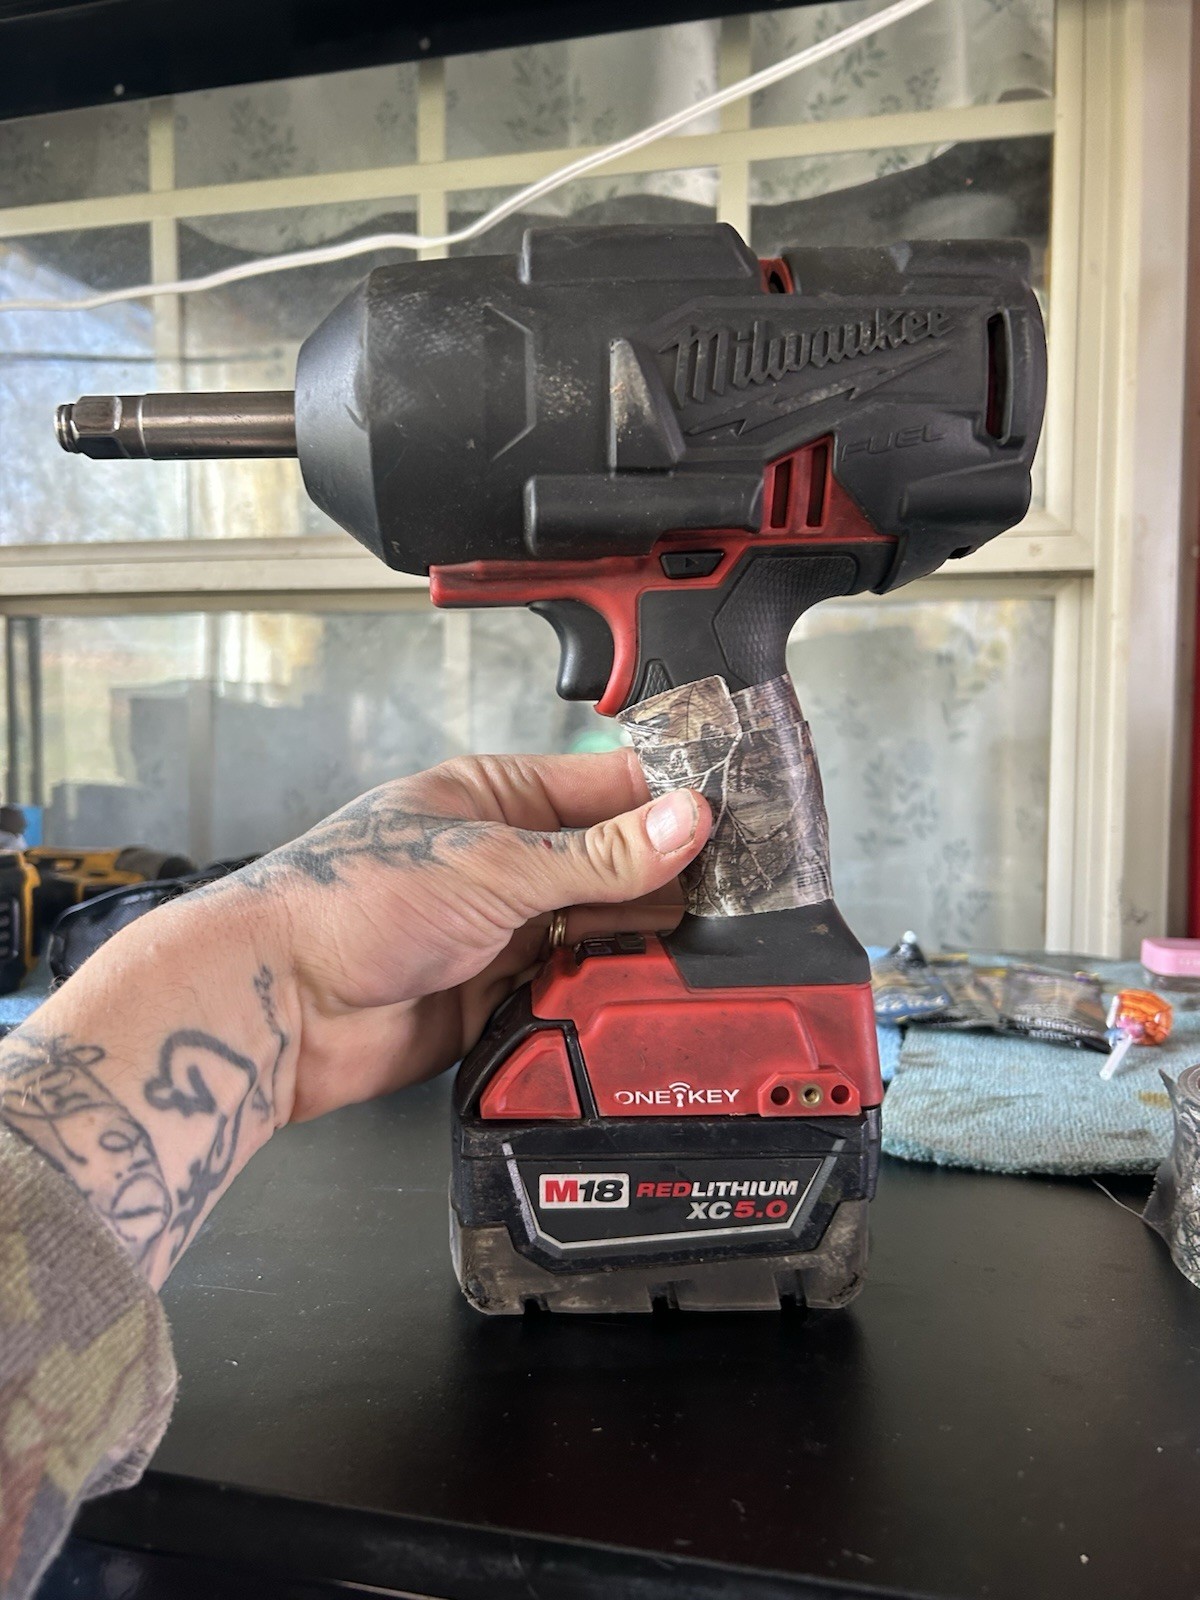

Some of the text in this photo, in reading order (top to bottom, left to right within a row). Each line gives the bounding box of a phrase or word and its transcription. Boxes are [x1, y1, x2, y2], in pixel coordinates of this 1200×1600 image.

[659, 308, 955, 410] Milwaukee
[841, 425, 947, 461] FUEL
[614, 1089, 740, 1105] ONE KEY
[545, 1179, 799, 1203] M18 REDLITHIUM
